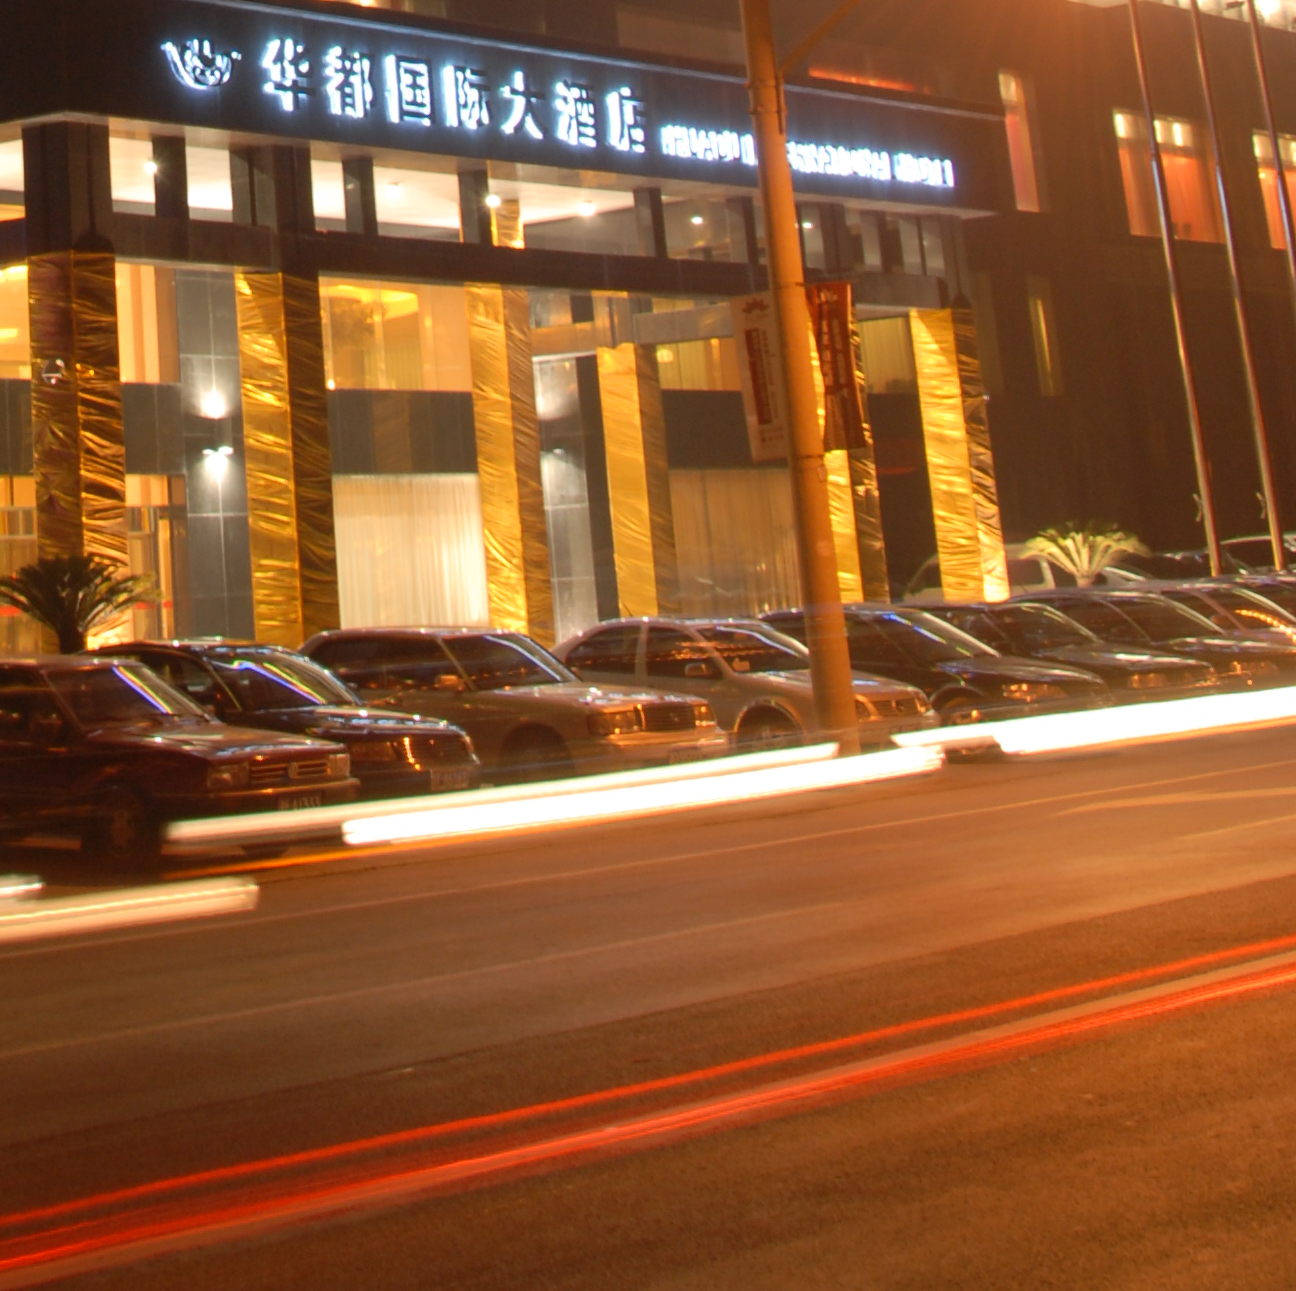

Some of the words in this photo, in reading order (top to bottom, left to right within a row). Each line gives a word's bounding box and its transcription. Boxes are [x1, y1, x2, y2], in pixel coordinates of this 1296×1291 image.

[262, 38, 646, 154] 华都国际大酒店
